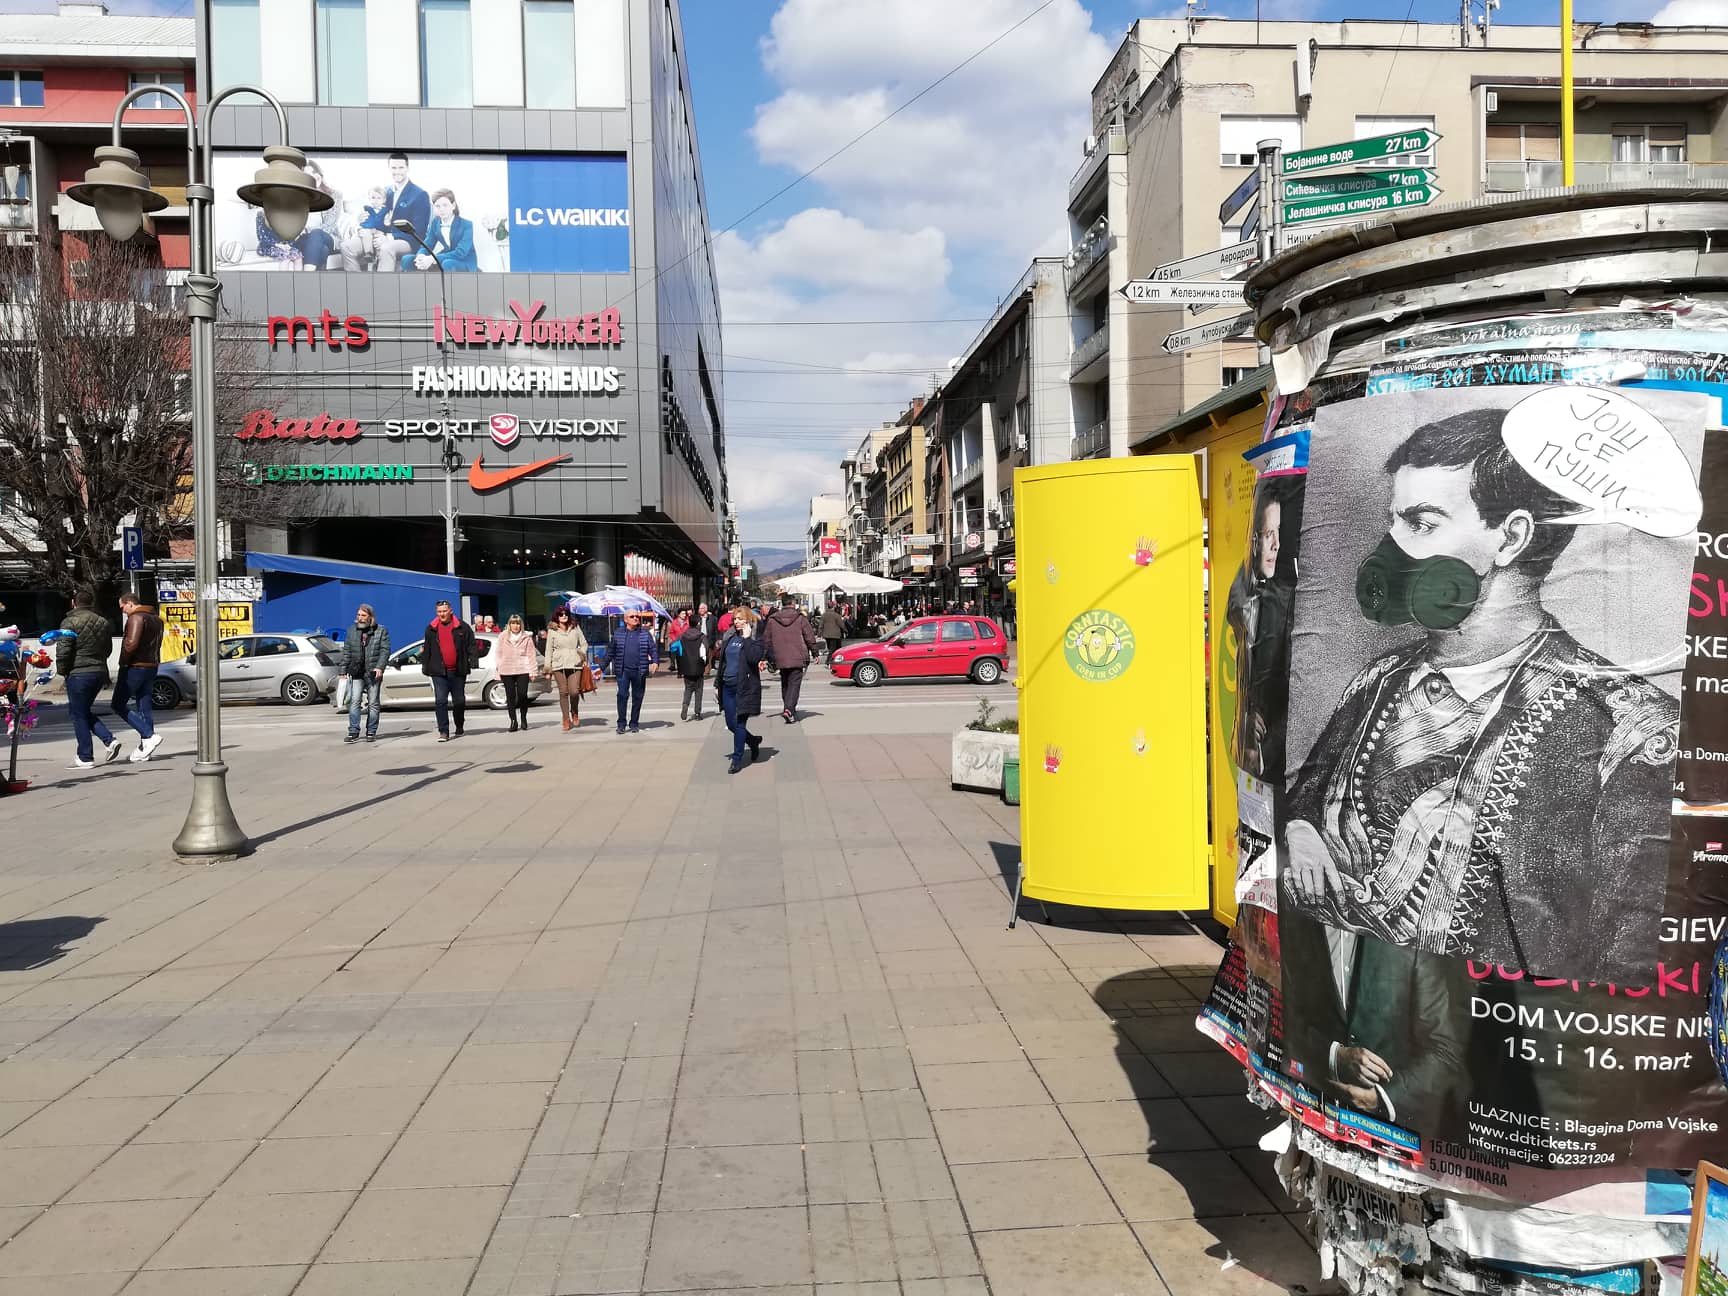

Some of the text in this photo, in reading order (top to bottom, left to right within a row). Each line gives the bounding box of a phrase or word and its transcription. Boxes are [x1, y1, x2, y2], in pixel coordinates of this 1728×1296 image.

[1285, 136, 1421, 170] Бојанине воде 27 km
[1338, 177, 1377, 191] клисура
[1388, 173, 1400, 187] 17
[1401, 172, 1419, 186] km
[515, 208, 544, 226] LC
[1287, 188, 1424, 219] Јелашничка клисура 16 km
[1169, 268, 1181, 279] km
[1220, 247, 1255, 264] Аеродром
[1145, 286, 1160, 298] km
[1169, 287, 1220, 298] Железничка
[1221, 289, 1244, 298] стани
[267, 309, 370, 347] mts
[1180, 335, 1191, 345] km
[412, 364, 620, 393] FASHION&FRIENDS
[236, 411, 620, 440] Bata SPORT VISION
[266, 464, 413, 481] DEICHMANN
[127, 531, 138, 552] P
[1065, 611, 1134, 649] CORNTASTIC
[1471, 996, 1545, 1030] DOM
[1554, 1009, 1667, 1038] VOJSKE
[1503, 1036, 1693, 1071] 15. i 16. mart
[1468, 1101, 1551, 1131] ULAZNICE
[1564, 1119, 1624, 1137] Blagajna
[1627, 1119, 1664, 1132] Doma
[1666, 1116, 1719, 1134] Vojske
[1468, 1121, 1598, 1152] www.ddtickets.rs
[1468, 1133, 1616, 1165] Informacije: 062321204
[1429, 1139, 1510, 1171] 15.000 DINARA
[1429, 1158, 1509, 1188] 5.000 DINARA
